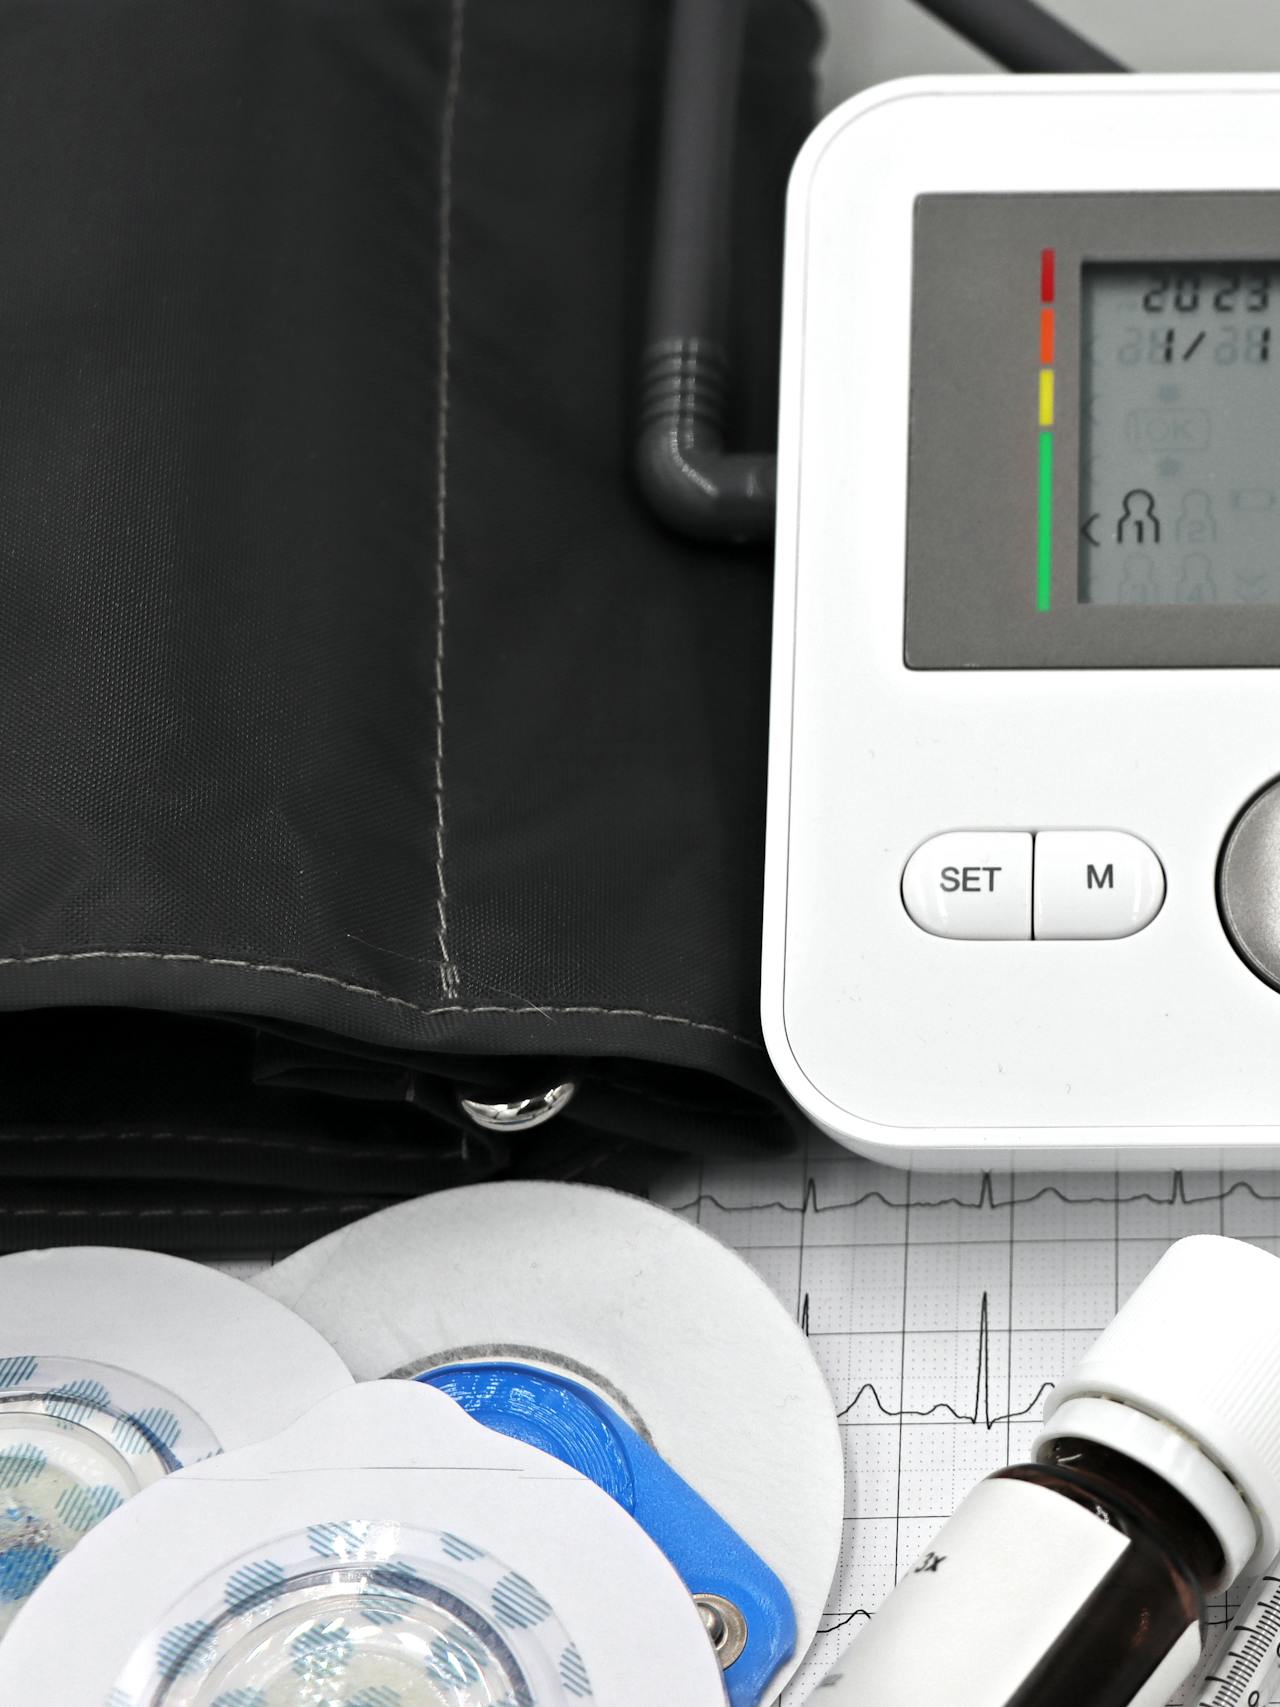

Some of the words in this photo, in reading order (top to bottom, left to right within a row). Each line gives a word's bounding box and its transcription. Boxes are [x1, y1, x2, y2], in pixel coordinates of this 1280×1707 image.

[1143, 274, 1269, 312] 2023
[940, 867, 1002, 892] SET
[1087, 864, 1114, 889] M
